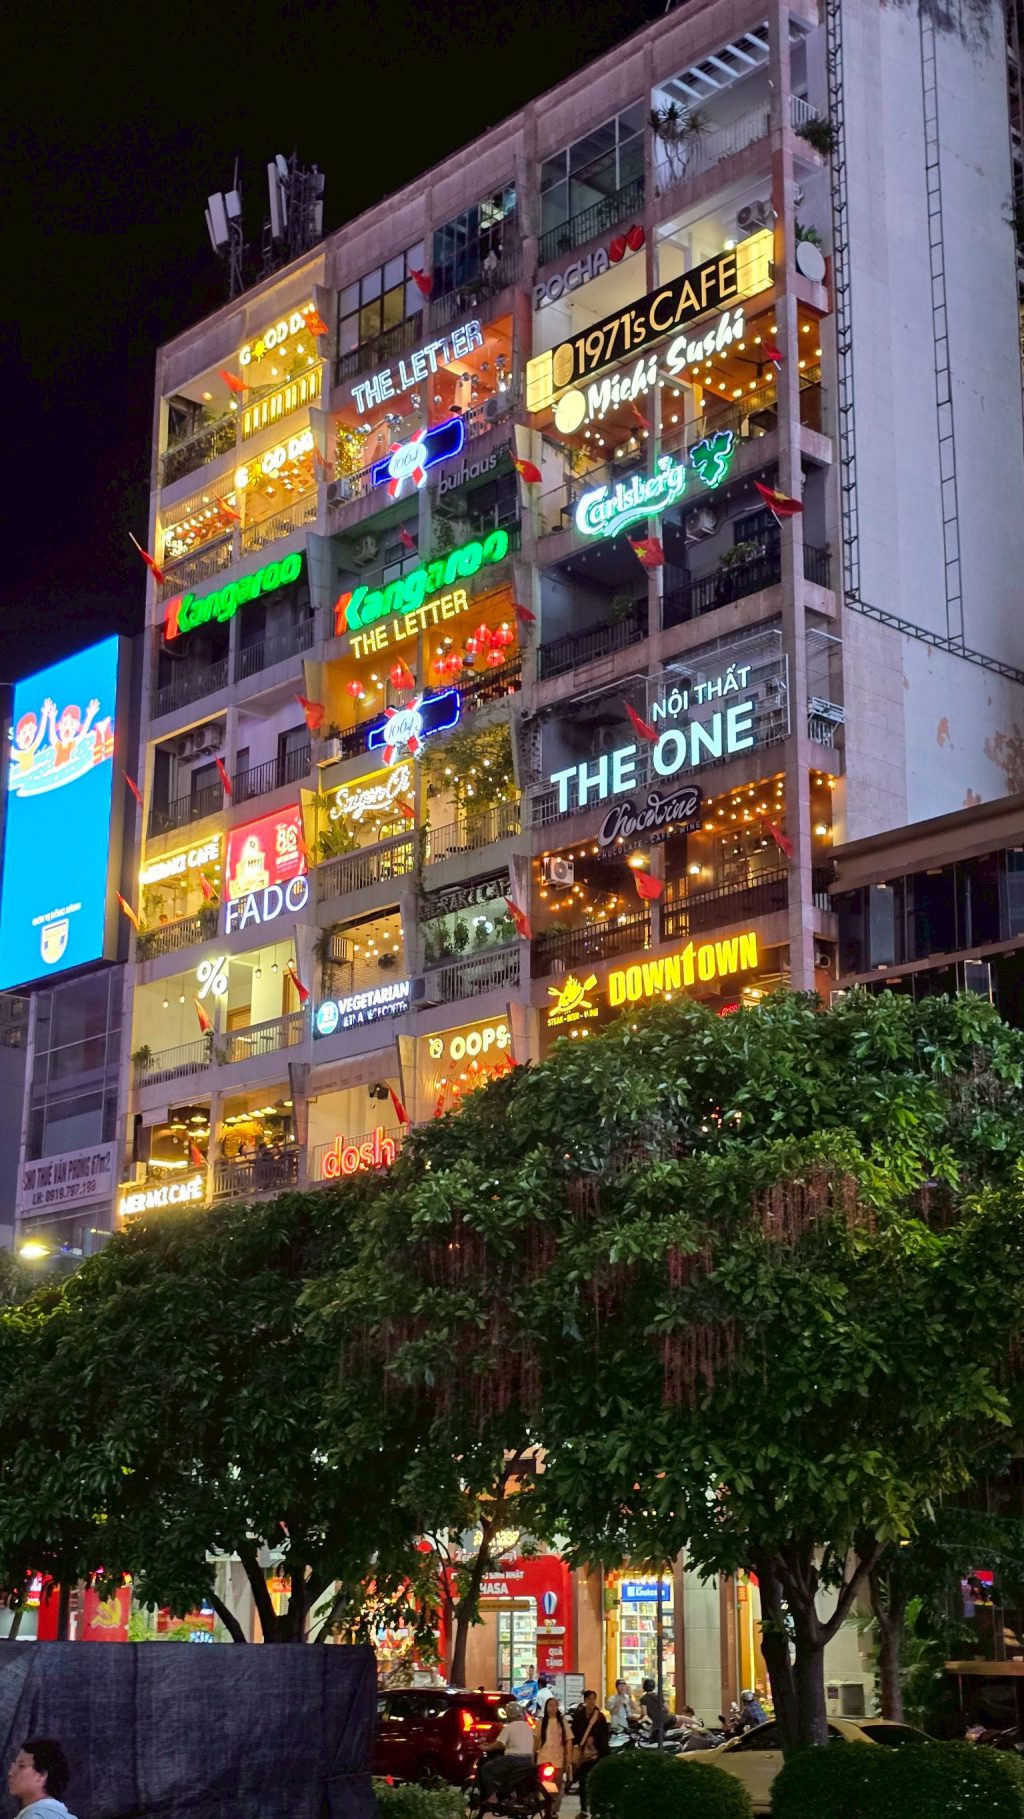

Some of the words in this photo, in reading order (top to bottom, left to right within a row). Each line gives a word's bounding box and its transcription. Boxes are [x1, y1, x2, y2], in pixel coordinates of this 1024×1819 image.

[533, 248, 609, 301] POCHA
[576, 310, 646, 374] 1971's
[649, 254, 736, 332] CAFE
[351, 374, 393, 414] THE
[399, 319, 483, 387] LETTER
[587, 354, 657, 418] Michi
[666, 308, 744, 374] Sushi
[576, 461, 686, 536] Carlsberg
[164, 553, 303, 641] Kangaroo
[334, 530, 509, 637] Kangaroo
[350, 628, 388, 659] THE
[394, 589, 469, 641] LETTER
[652, 691, 688, 722] NỘI
[694, 662, 751, 704] THẤT
[551, 745, 637, 813] THE
[653, 701, 753, 776] ONE
[680, 821, 701, 834] WINE
[225, 875, 309, 934] FADO
[338, 980, 410, 1015] VEGETARIAN
[450, 1024, 507, 1060] OOPS
[323, 1126, 395, 1179] dosh
